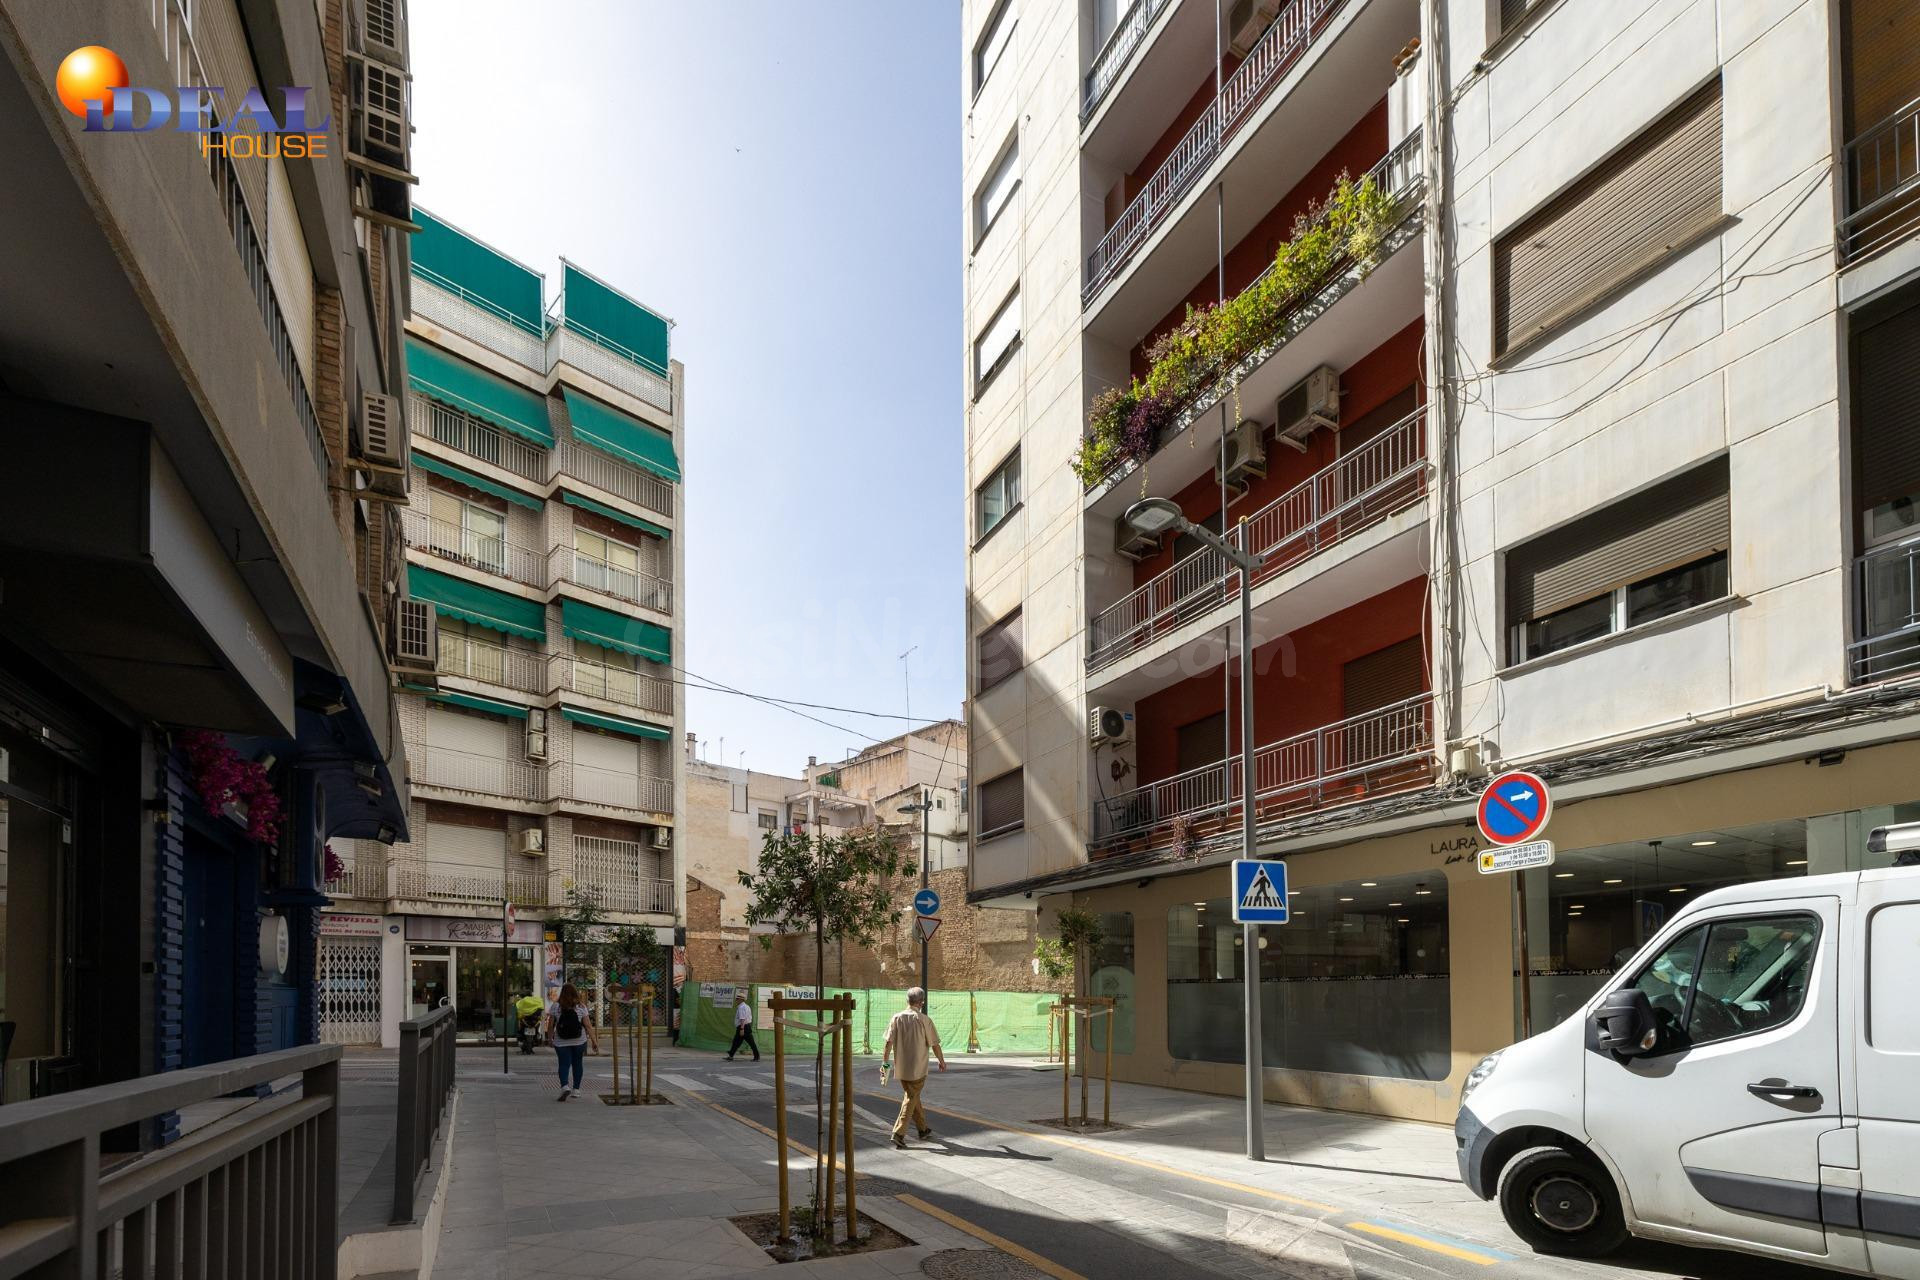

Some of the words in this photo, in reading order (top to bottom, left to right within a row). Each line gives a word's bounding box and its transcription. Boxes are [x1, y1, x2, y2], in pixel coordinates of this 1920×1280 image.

[1431, 836, 1479, 854] LAURA
[330, 916, 380, 924] REVISTAS
[1586, 969, 1611, 977] LAURA
[715, 986, 733, 996] tuyser
